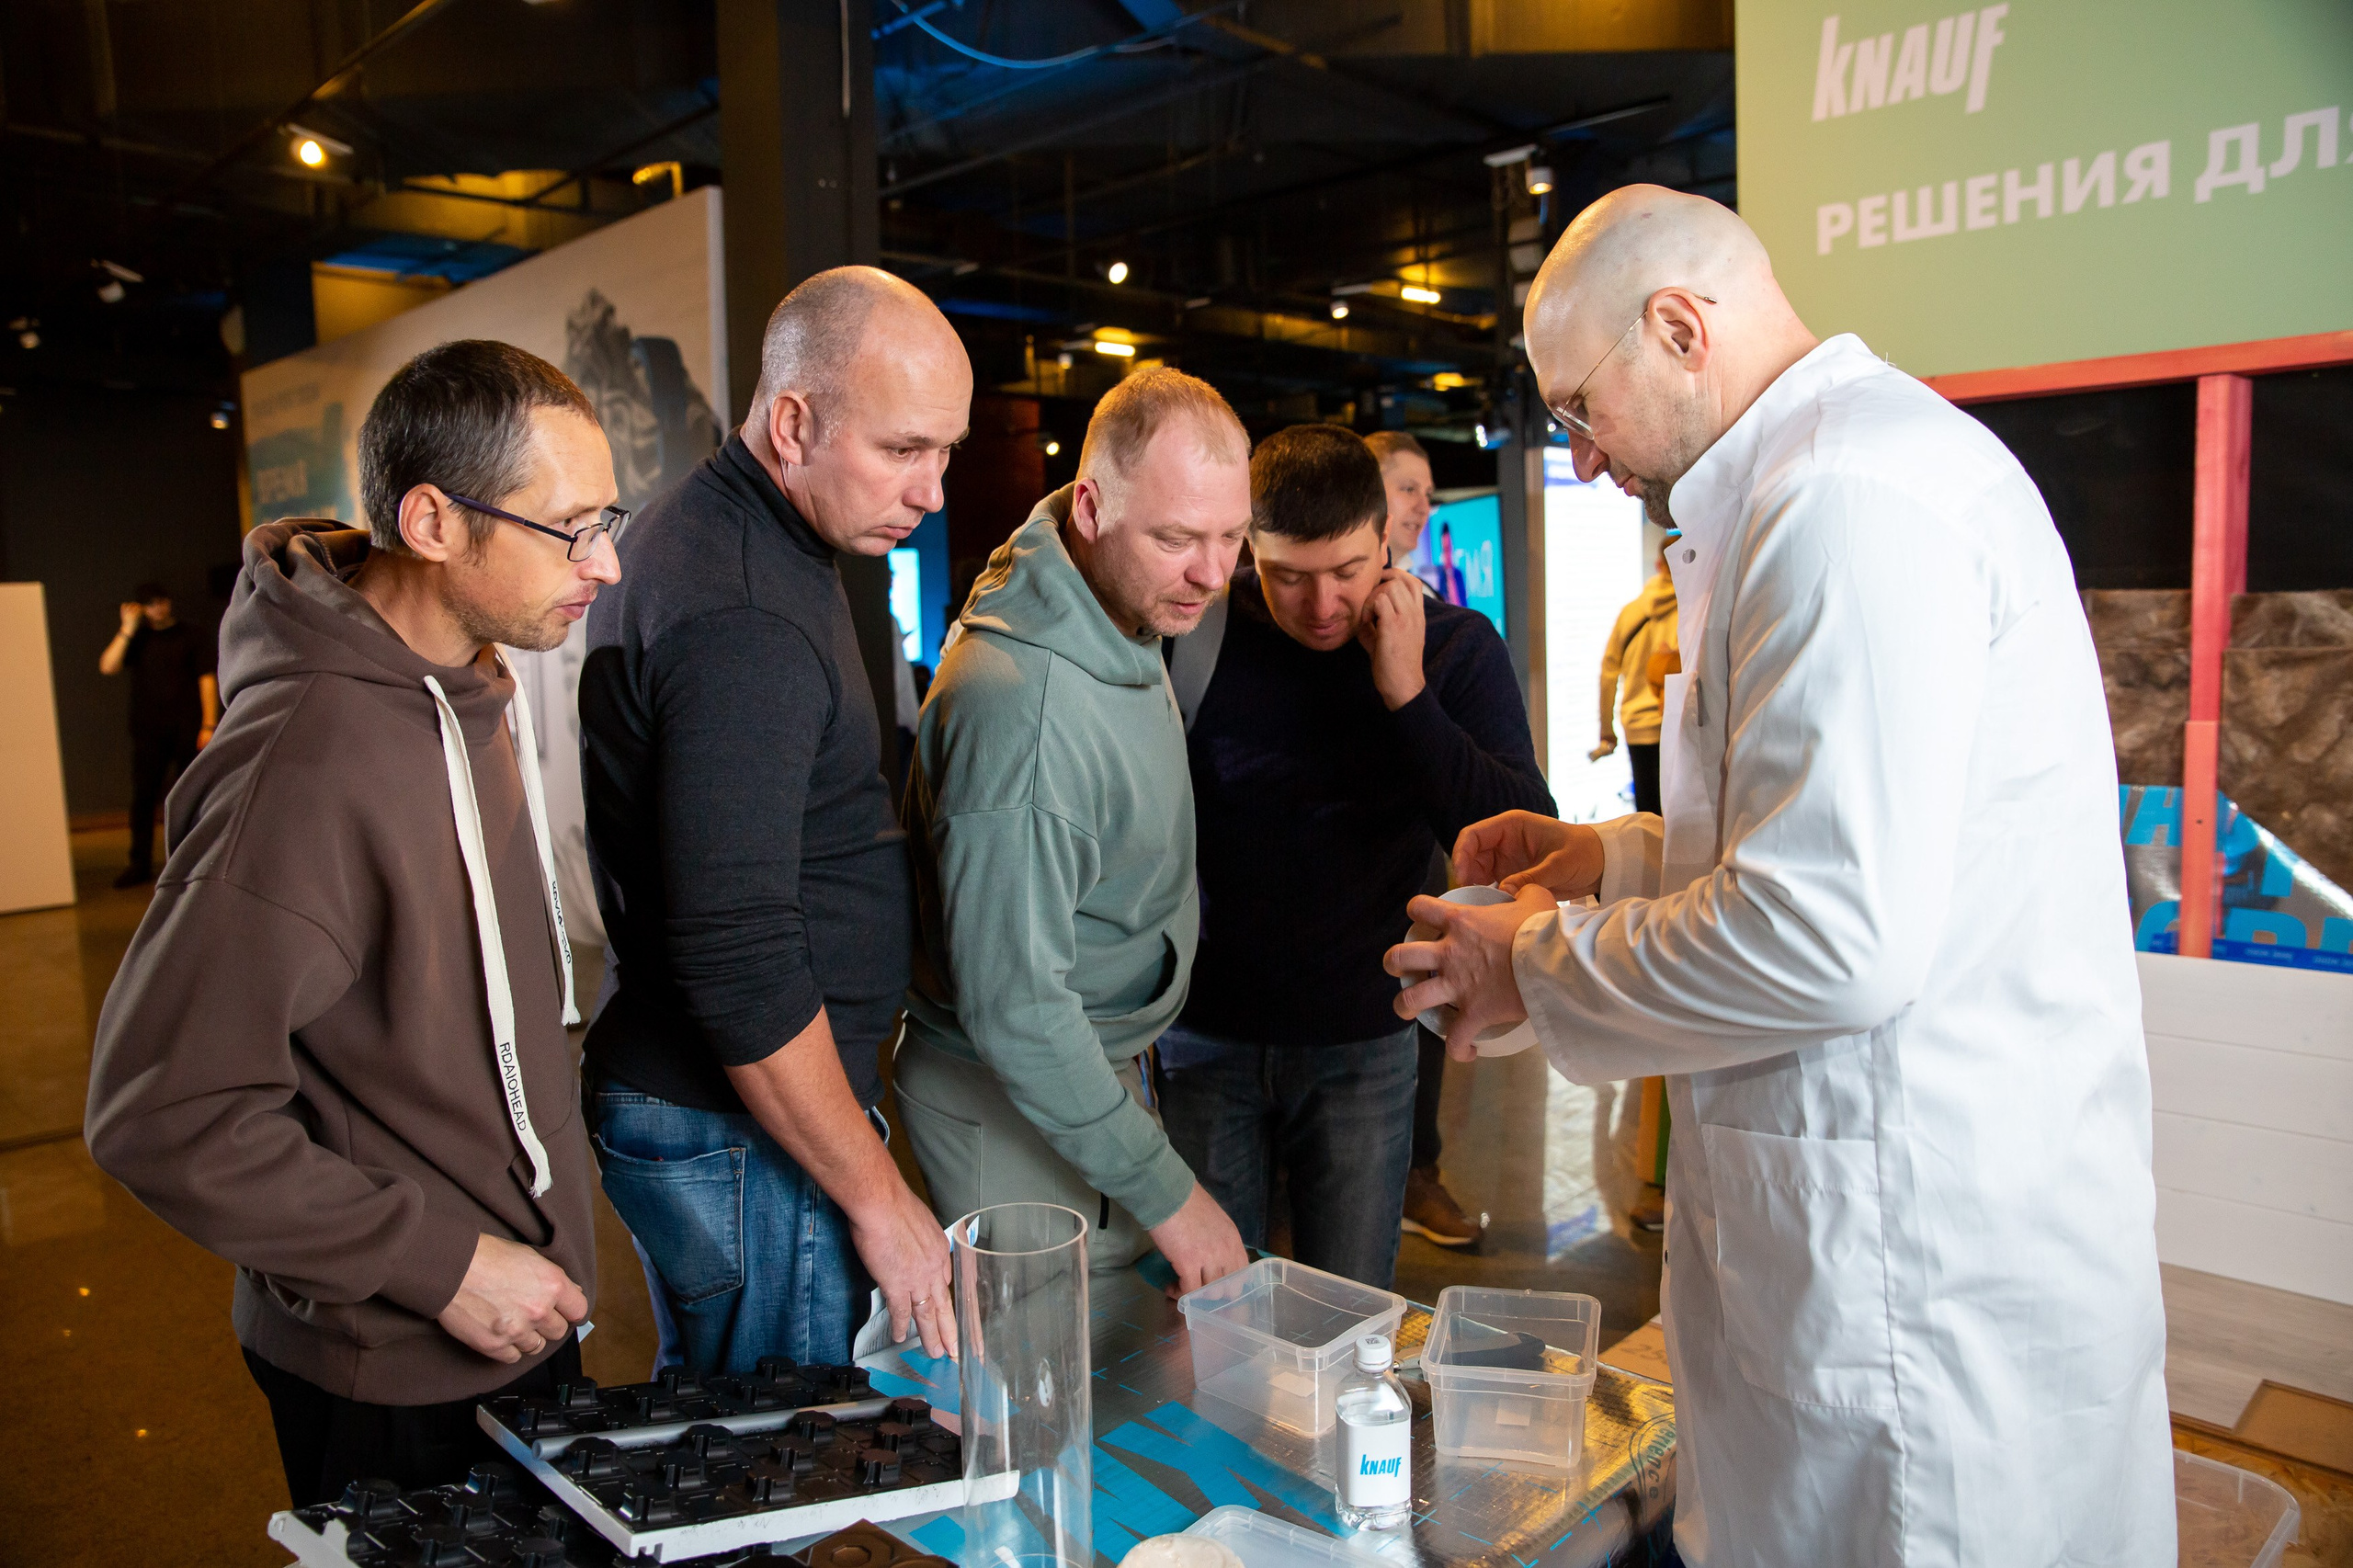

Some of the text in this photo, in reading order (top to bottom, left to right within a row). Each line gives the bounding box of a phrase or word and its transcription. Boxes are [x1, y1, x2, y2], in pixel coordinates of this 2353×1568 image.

[1816, 106, 2353, 256] РЕШЕНИЯ ДЛ
[499, 1041, 527, 1131] RDAIOHEAD
